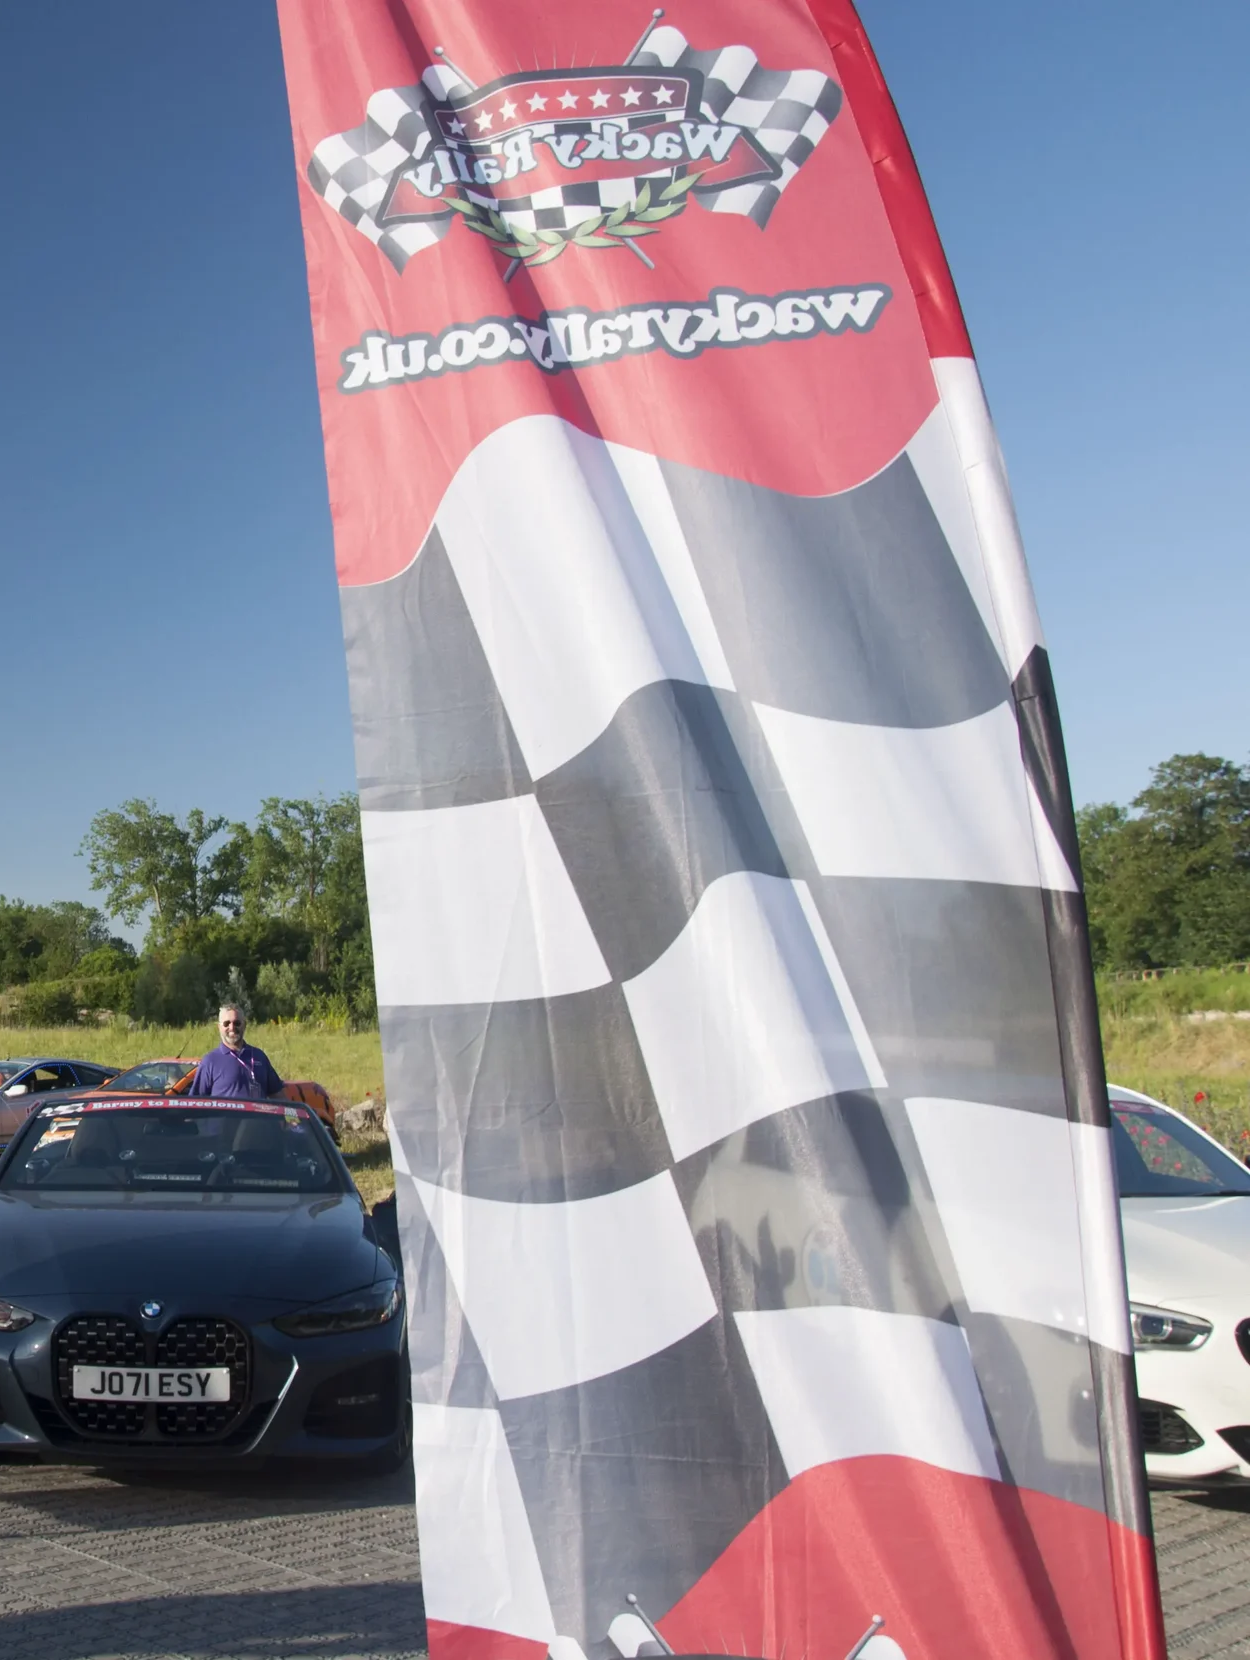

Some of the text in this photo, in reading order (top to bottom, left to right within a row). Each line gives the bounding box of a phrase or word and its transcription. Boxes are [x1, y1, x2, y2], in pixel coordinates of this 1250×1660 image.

[92, 1100, 143, 1109] Barmy
[168, 1099, 245, 1109] Barcelona
[159, 1373, 211, 1396] ESY
